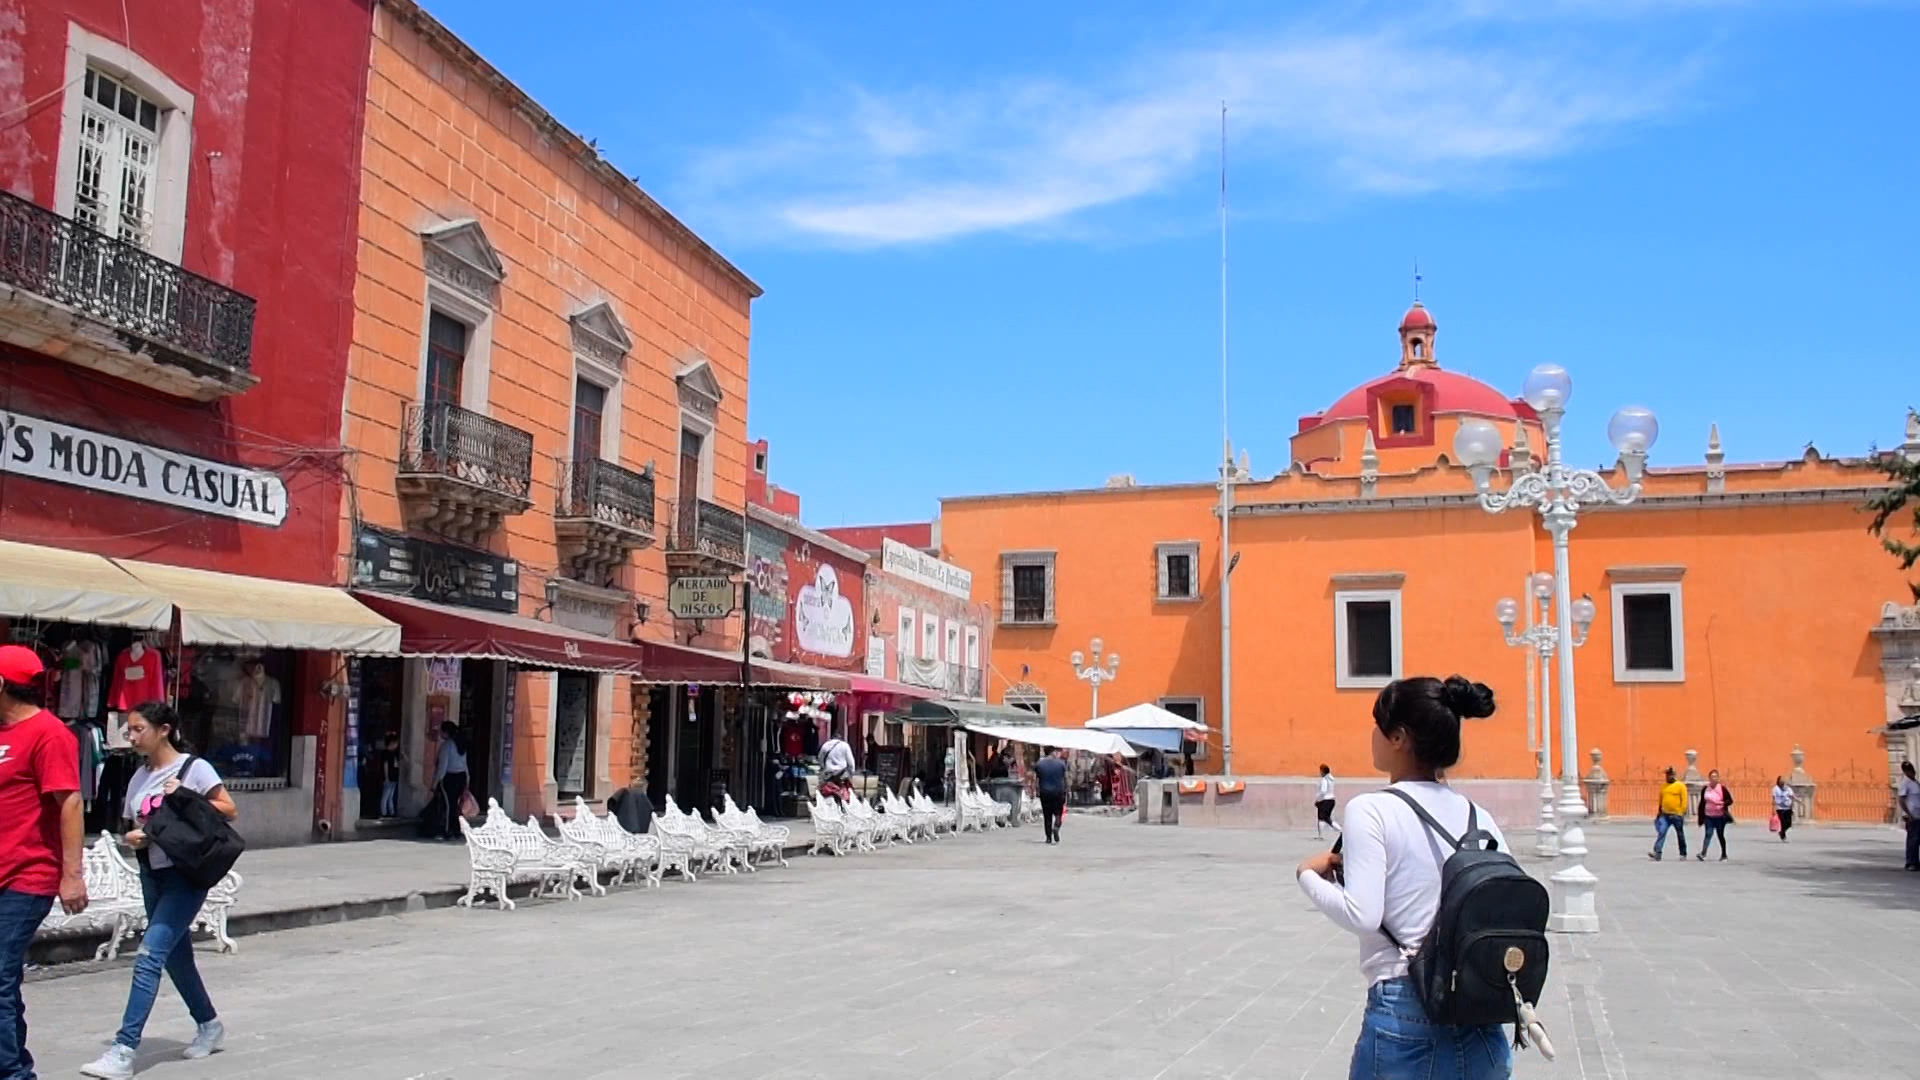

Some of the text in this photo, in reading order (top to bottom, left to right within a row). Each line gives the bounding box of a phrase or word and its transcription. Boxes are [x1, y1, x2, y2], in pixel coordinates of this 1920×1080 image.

[0, 415, 276, 516] 'S MODA CASUAL
[677, 579, 727, 590] MERCADO
[692, 591, 707, 602] DE
[680, 603, 723, 614] DISCOS
